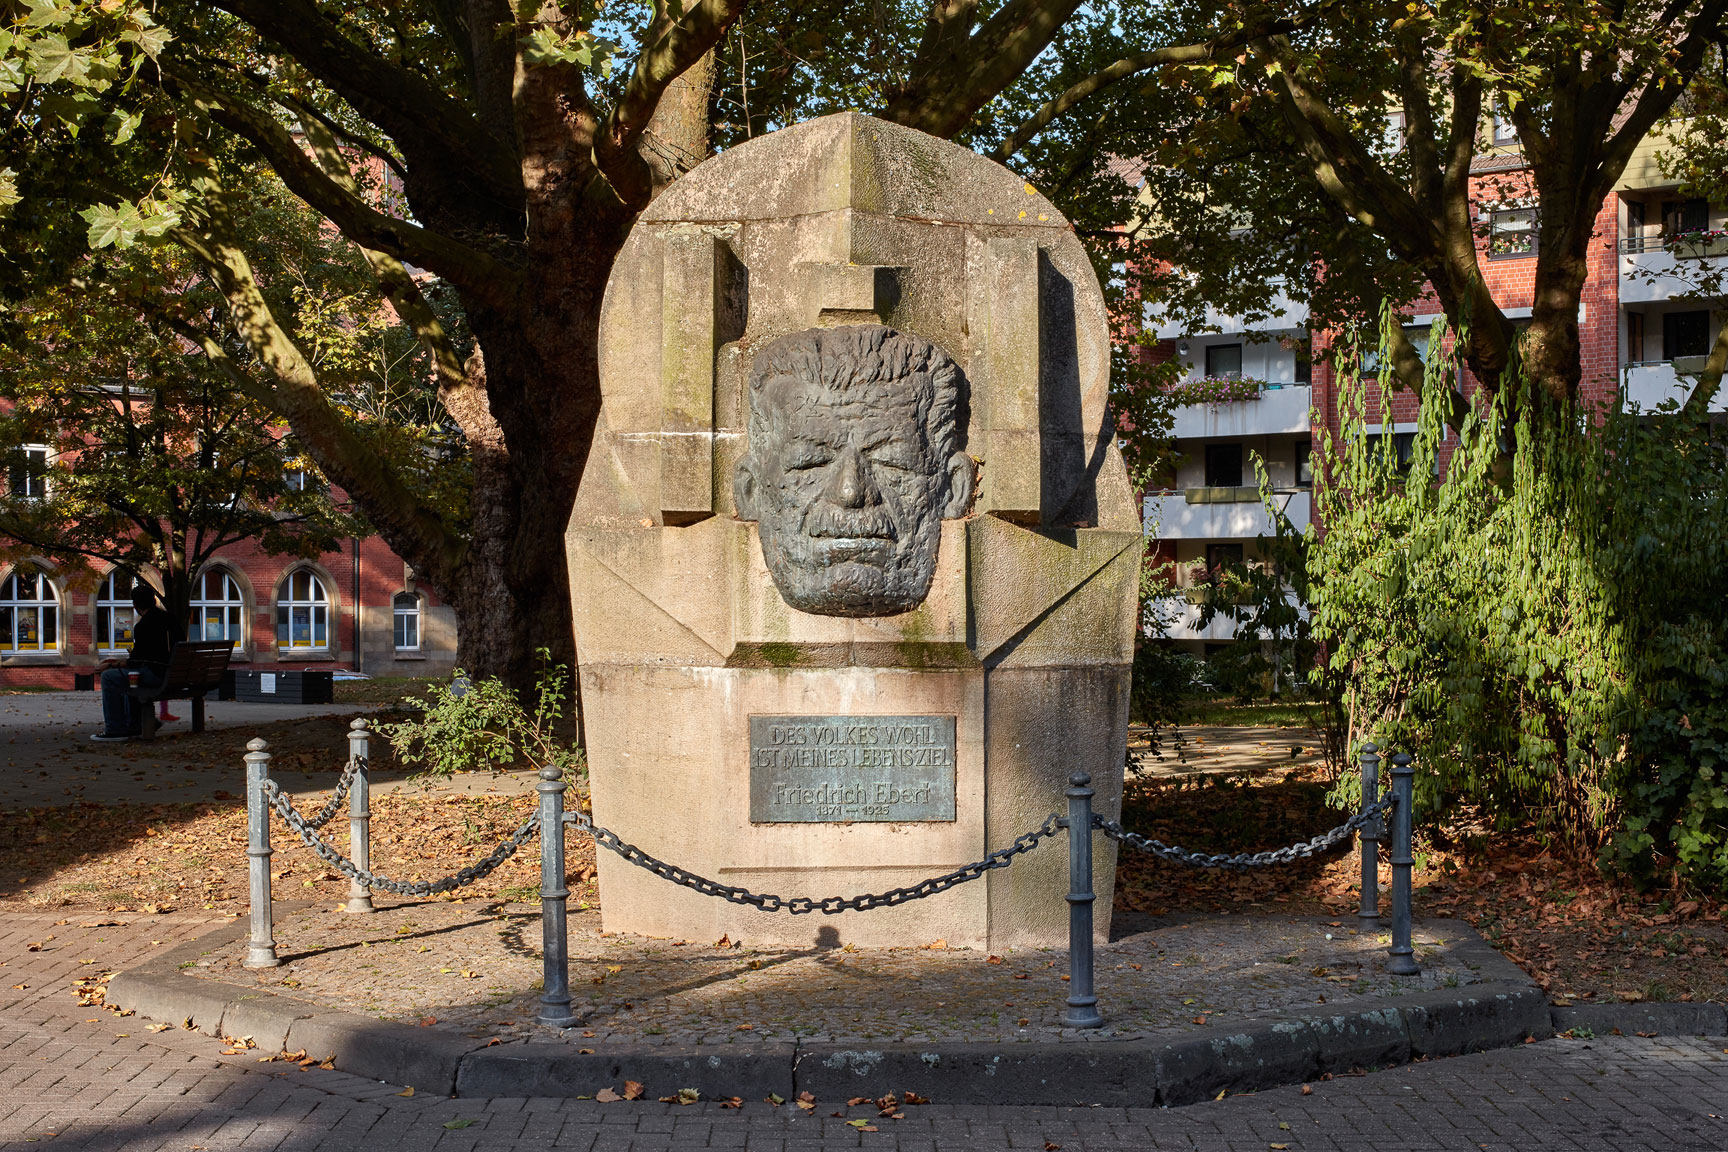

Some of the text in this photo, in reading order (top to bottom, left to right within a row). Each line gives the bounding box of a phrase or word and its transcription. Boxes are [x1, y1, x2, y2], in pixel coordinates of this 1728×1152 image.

[770, 725, 936, 745] DES VOLKES WOHL
[755, 748, 780, 768] IST
[782, 748, 849, 768] MEINES
[773, 781, 931, 805] Friedrich Ebert
[816, 805, 842, 816] 1871
[861, 805, 890, 816] 1925
